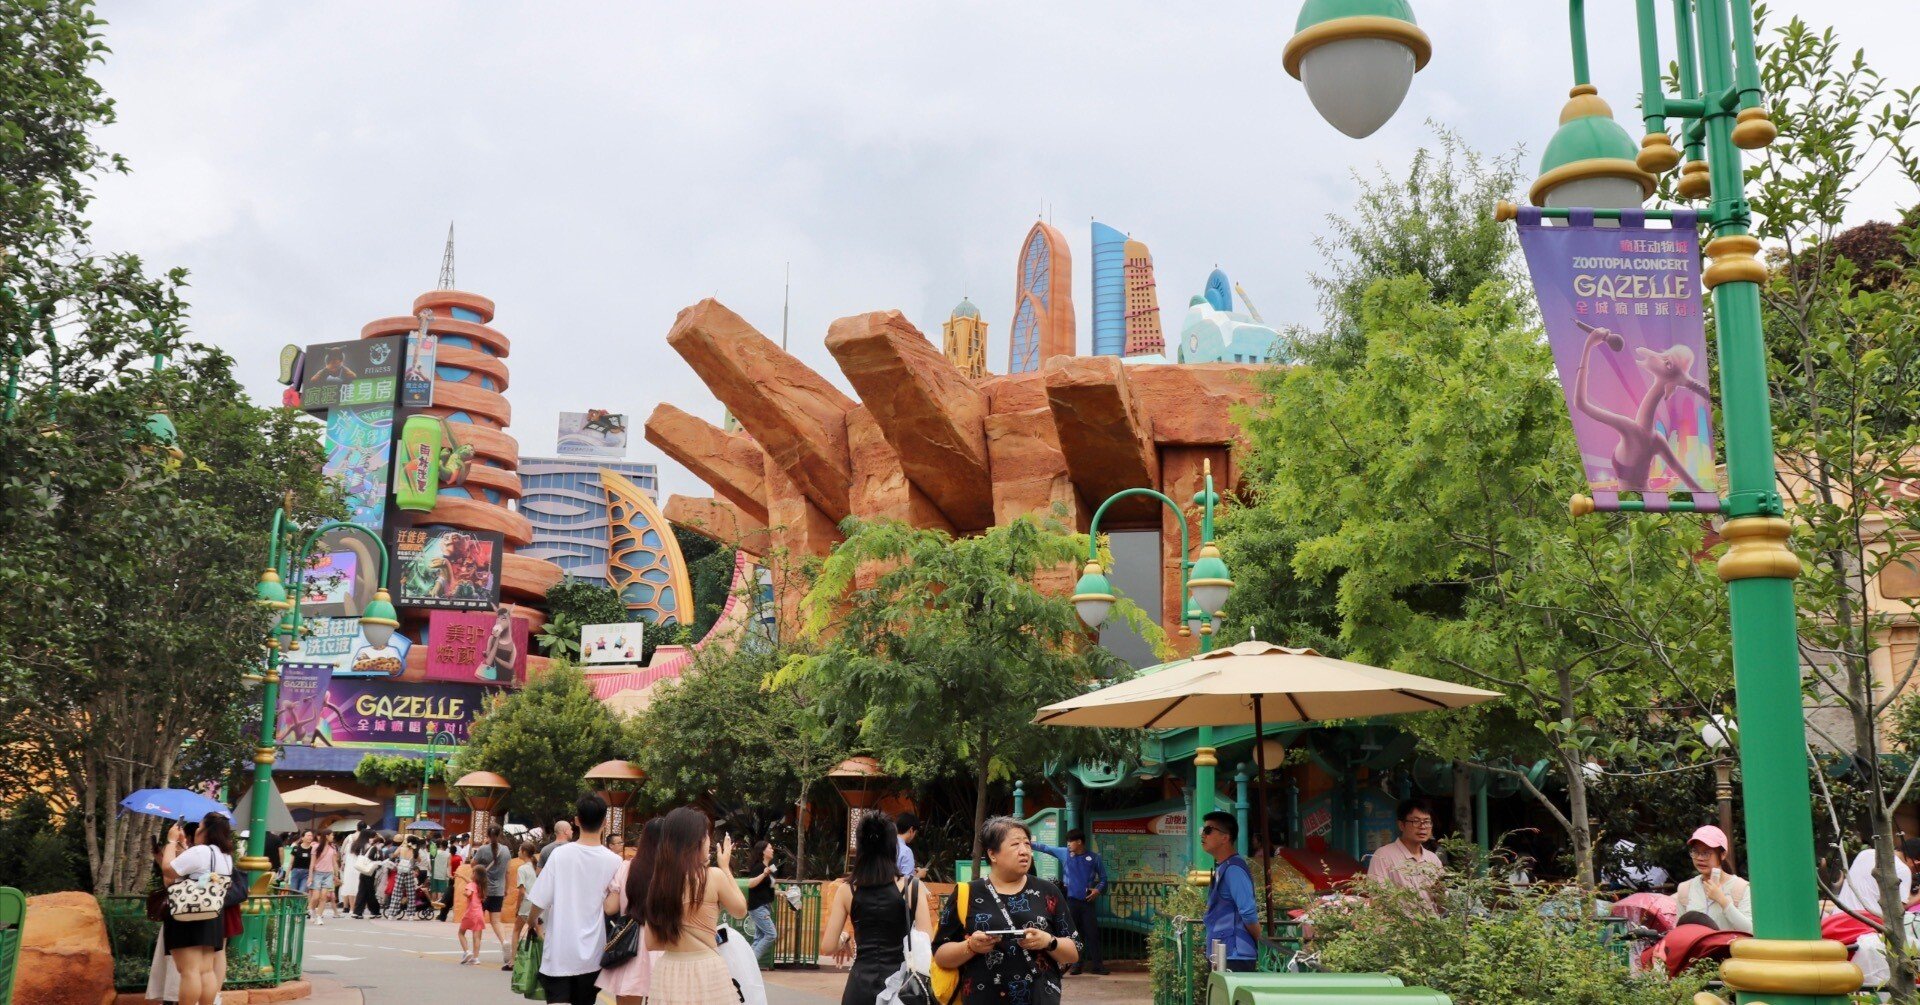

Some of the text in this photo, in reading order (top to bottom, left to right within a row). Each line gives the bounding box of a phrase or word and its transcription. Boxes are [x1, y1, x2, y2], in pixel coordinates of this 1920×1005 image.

[1620, 239, 1689, 254] 疯狂动物城
[1573, 256, 1689, 271] ZOOTOPIA CONCERT
[1573, 274, 1692, 301] GAZELLE
[364, 366, 392, 375] FITNESS
[283, 680, 319, 689] GAZELLE
[356, 694, 464, 720] GAZELLE
